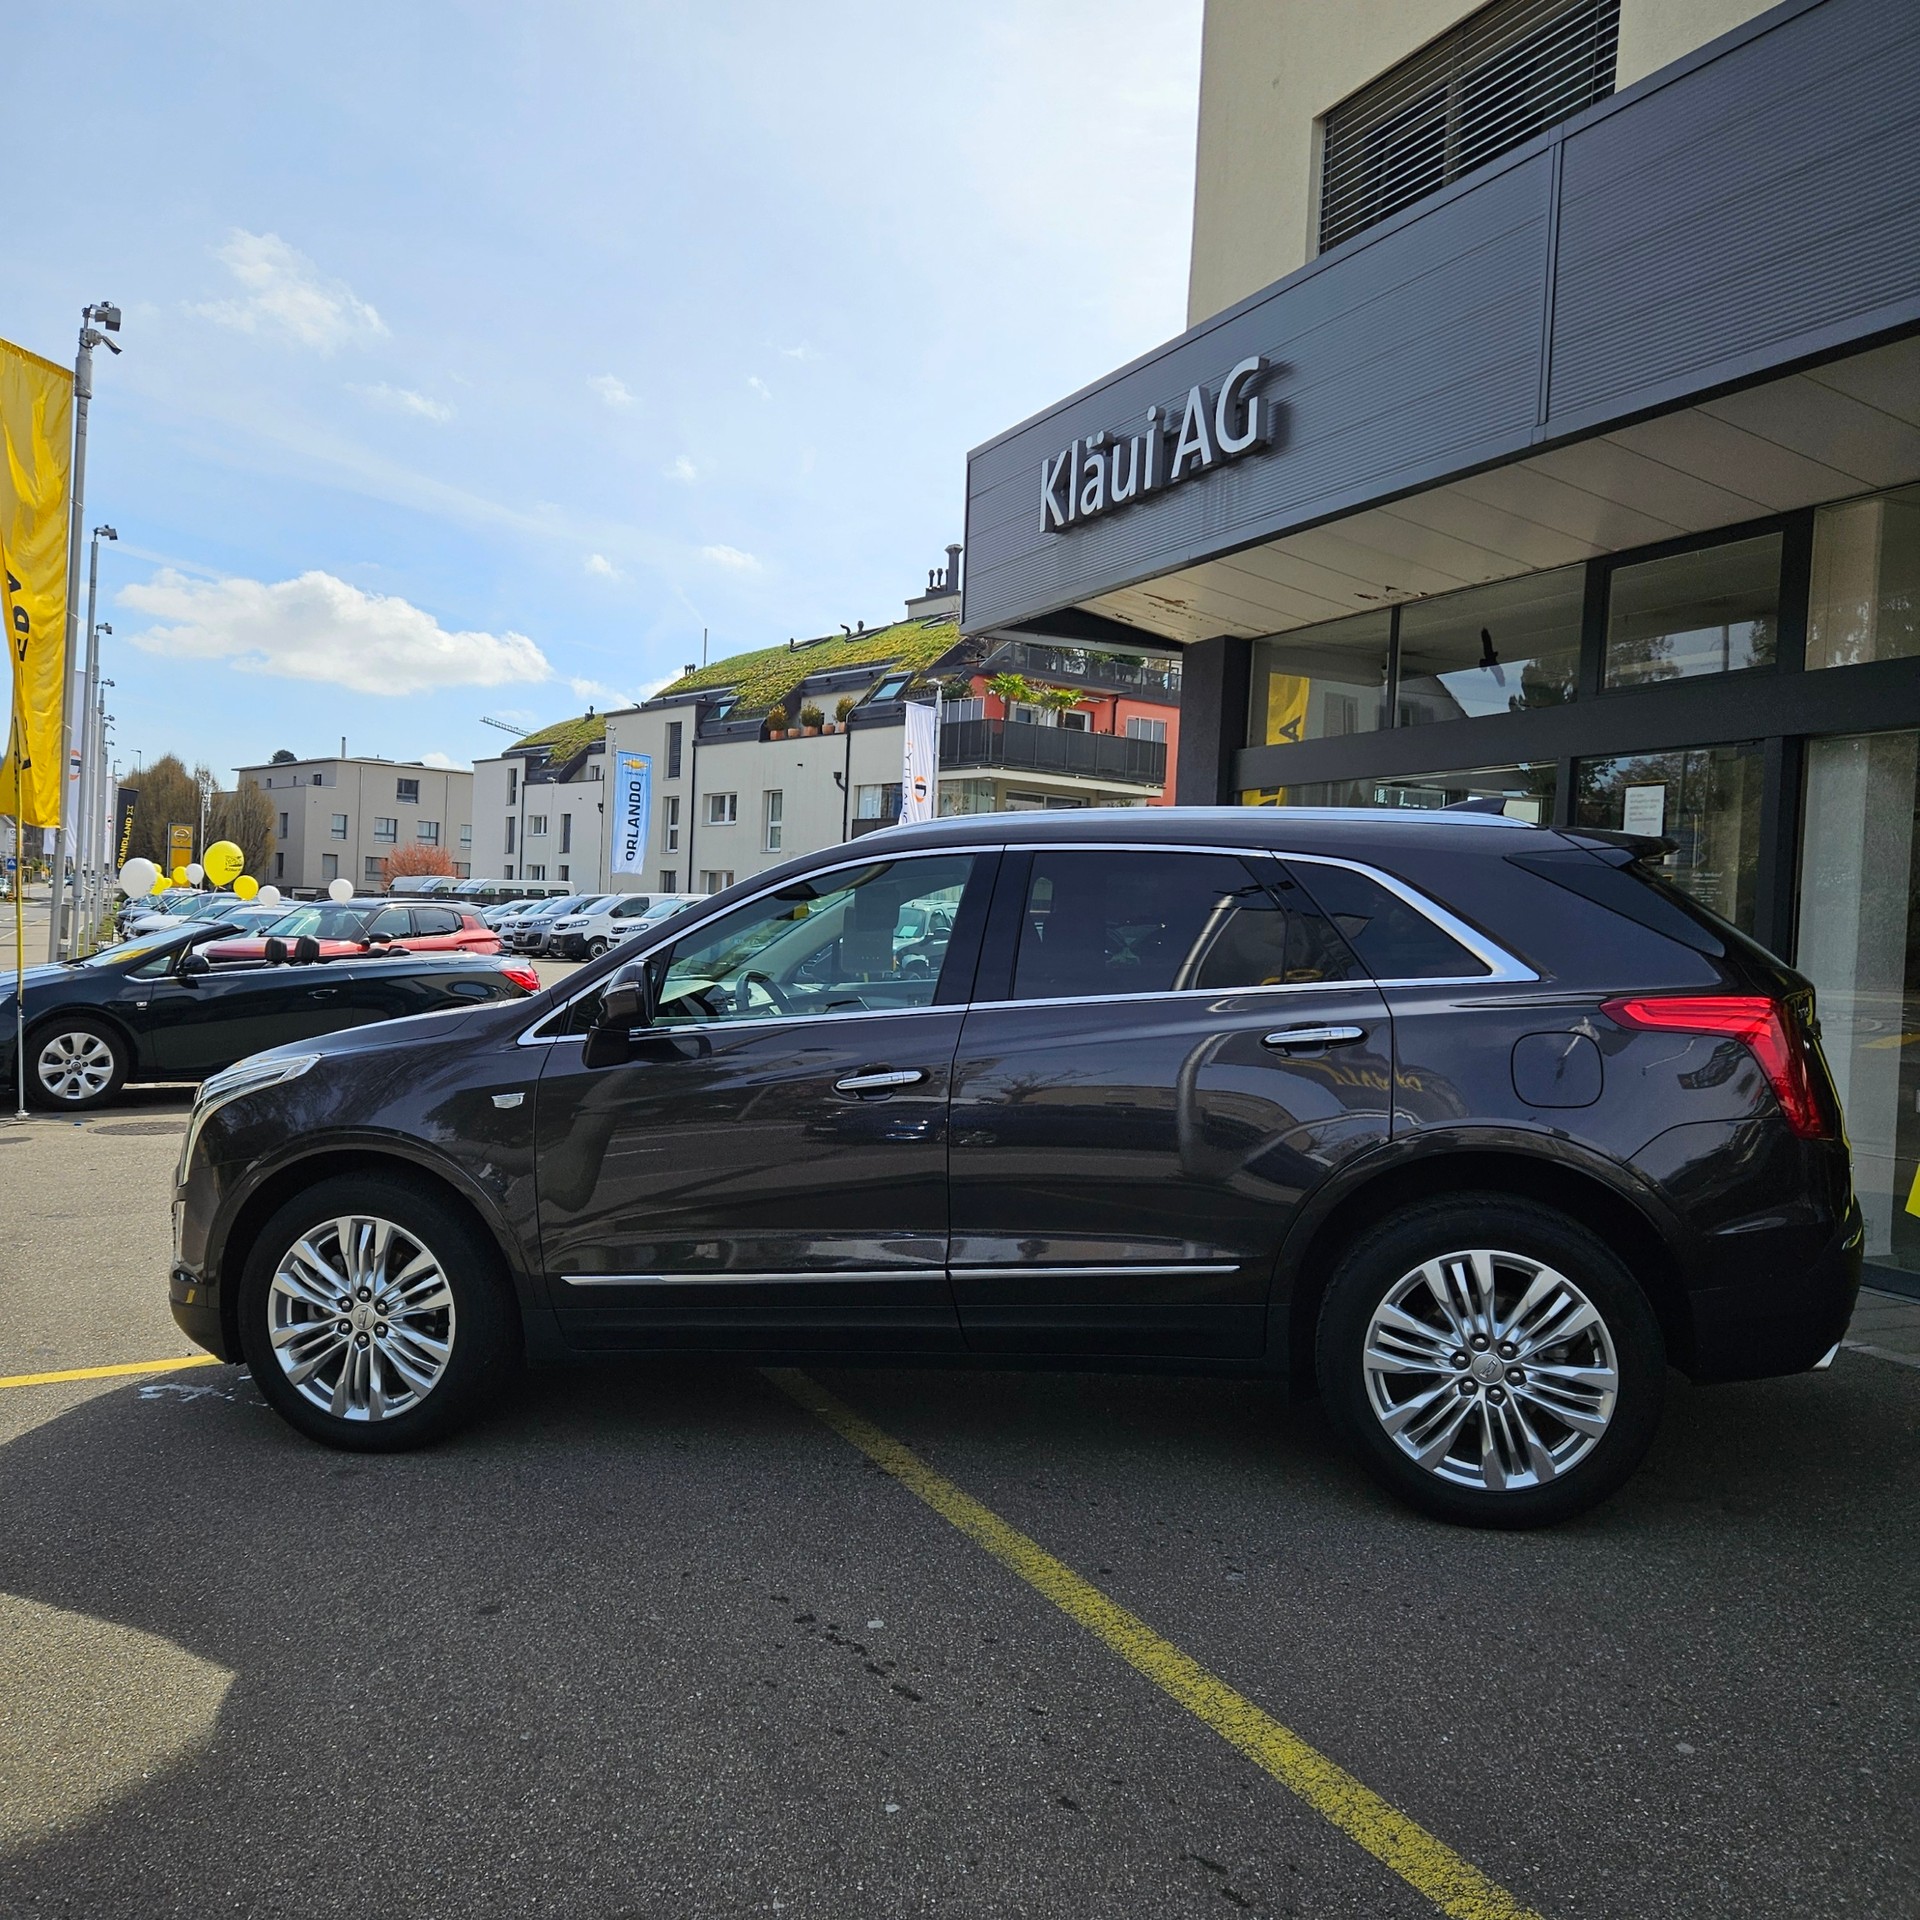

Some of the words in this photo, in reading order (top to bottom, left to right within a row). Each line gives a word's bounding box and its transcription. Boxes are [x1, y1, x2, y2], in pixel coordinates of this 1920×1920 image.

[1039, 405, 1162, 533] Kläui
[1171, 355, 1266, 480] AG
[117, 817, 133, 869] GRANDLAND
[625, 780, 642, 862] ORLANDO
